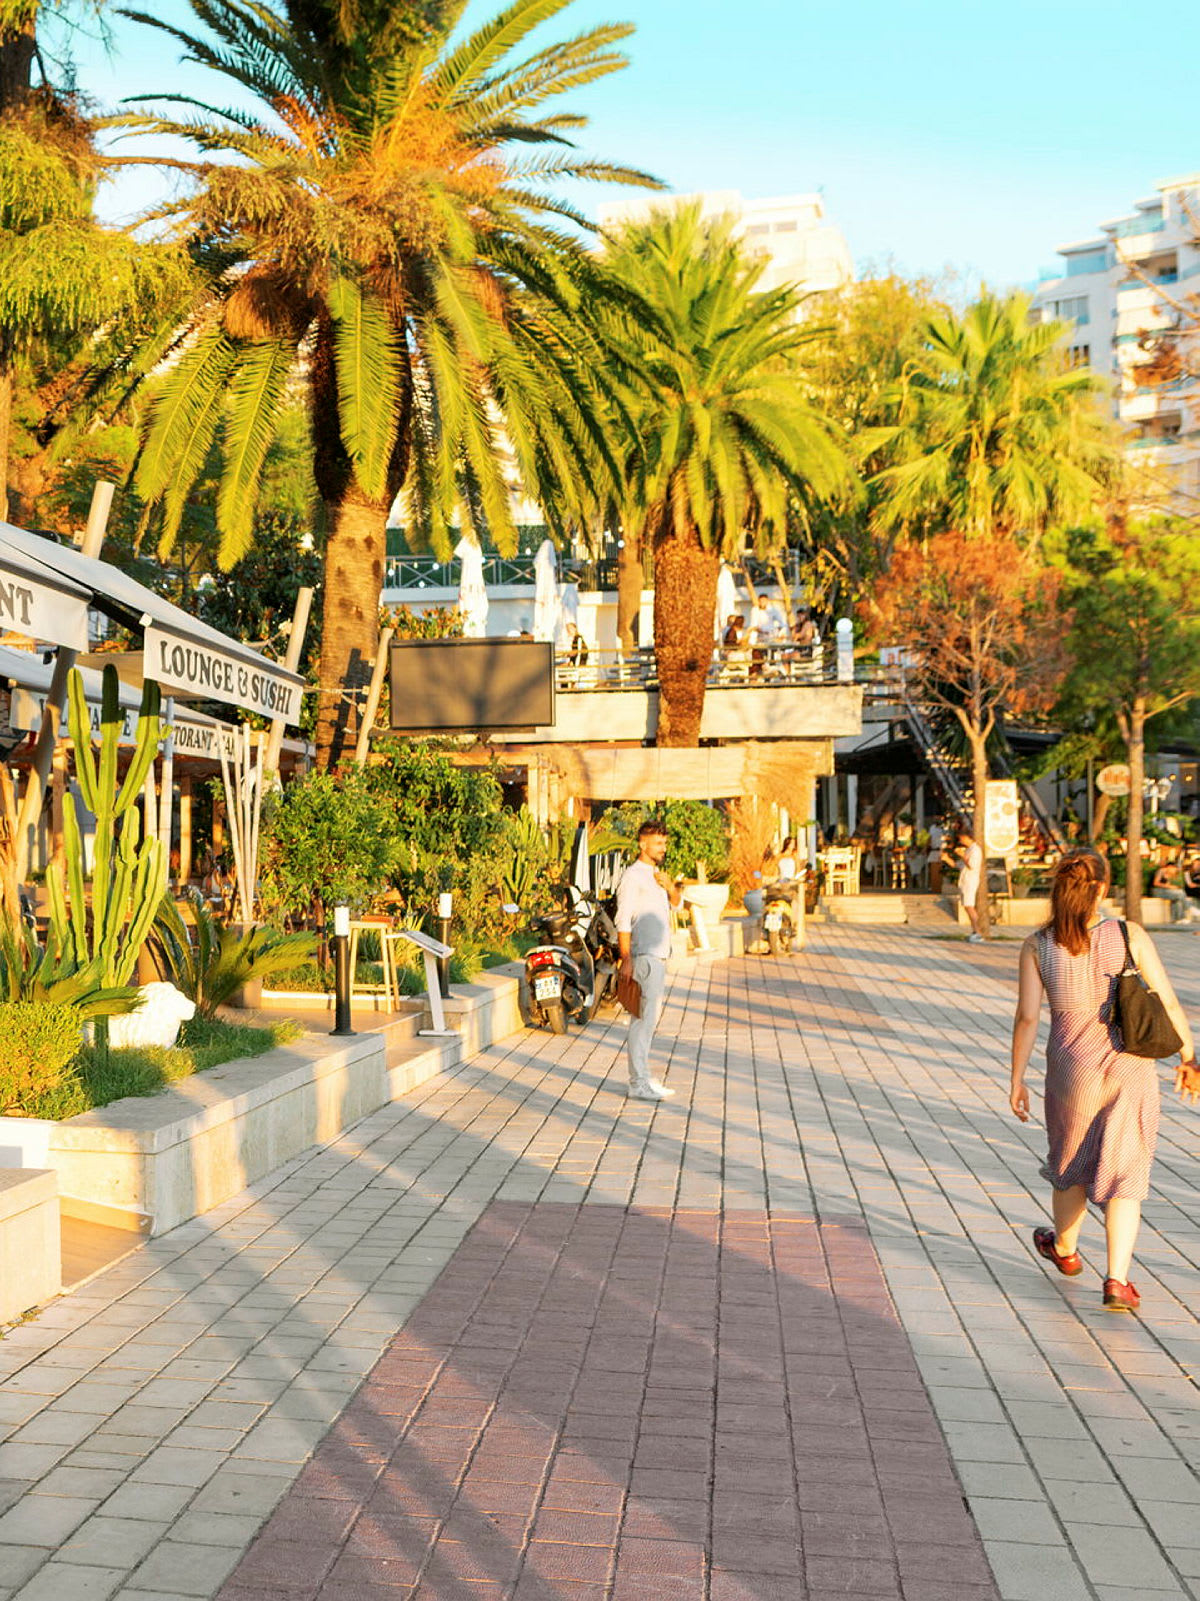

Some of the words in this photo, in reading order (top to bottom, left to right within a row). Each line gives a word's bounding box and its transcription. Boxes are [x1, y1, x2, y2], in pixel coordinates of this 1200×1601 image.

[160, 640, 234, 694] LOUNGE
[238, 667, 248, 697] &
[251, 674, 293, 715] SUSHI
